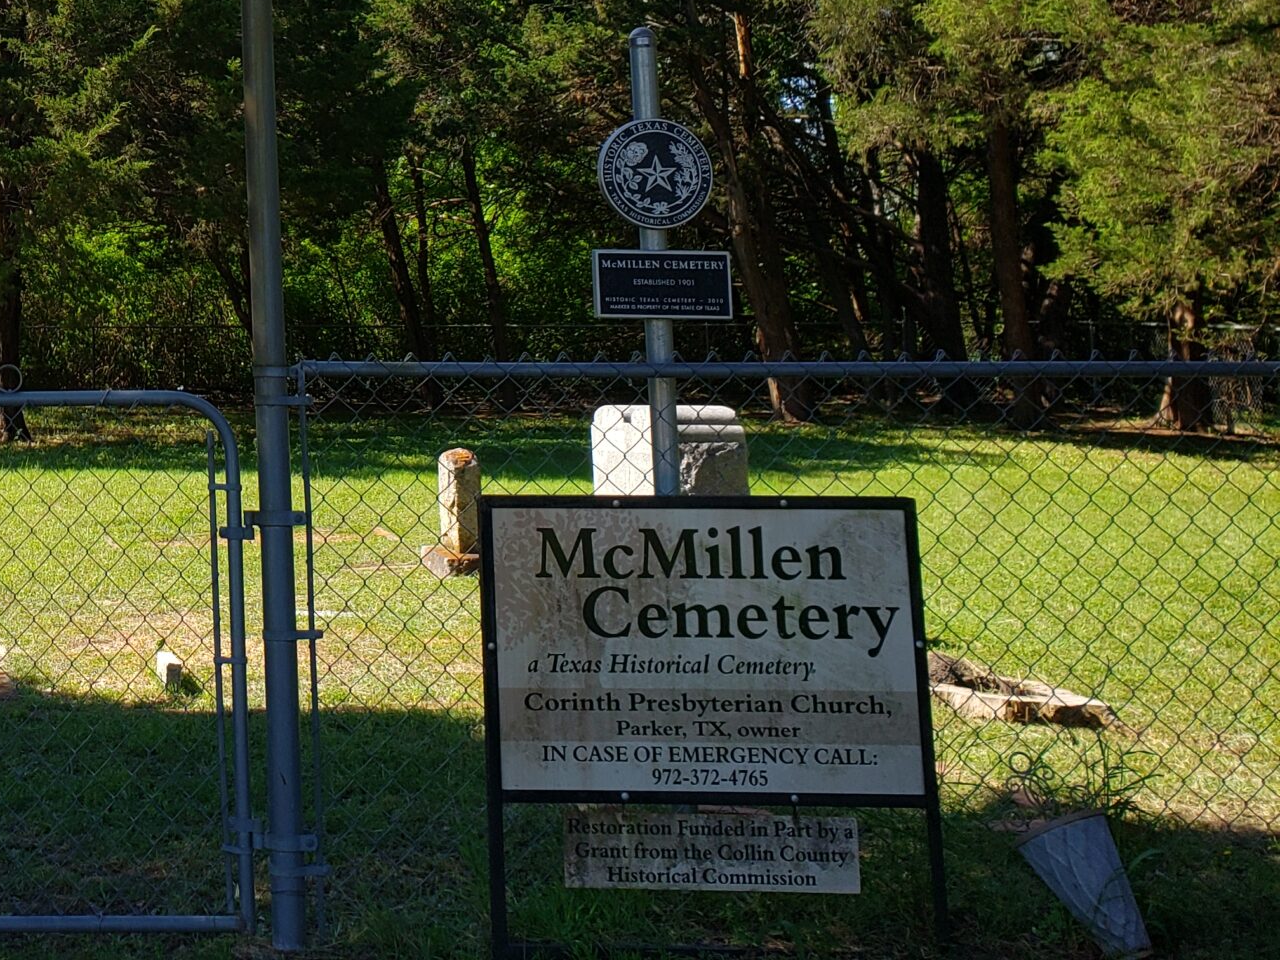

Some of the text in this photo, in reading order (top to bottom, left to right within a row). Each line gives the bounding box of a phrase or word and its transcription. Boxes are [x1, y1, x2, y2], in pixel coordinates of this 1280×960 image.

[604, 121, 711, 182] HISTORIC TEXAS CEMETERY
[611, 191, 708, 225] TEXAS HISTORICAL COMMISSION
[601, 259, 725, 270] McMILLEN CEMETERY
[633, 278, 695, 287] ESTABLISHED 1901
[535, 525, 847, 581] McMillen
[581, 585, 901, 658] Cemetery
[527, 658, 539, 673] a
[547, 653, 602, 673] Texas
[608, 653, 710, 674] Historical
[524, 692, 892, 719] Corinth Presbyterian Church,
[616, 720, 801, 739] Parker, TX, owner
[542, 745, 879, 766] IN CASE OF EMERGENCY CALL:
[651, 768, 769, 787] 972-372-4765
[567, 818, 854, 843] Restoration Funded in Part by a
[574, 842, 850, 868] Grant from the Collin County
[607, 866, 818, 887] Historical Commission
